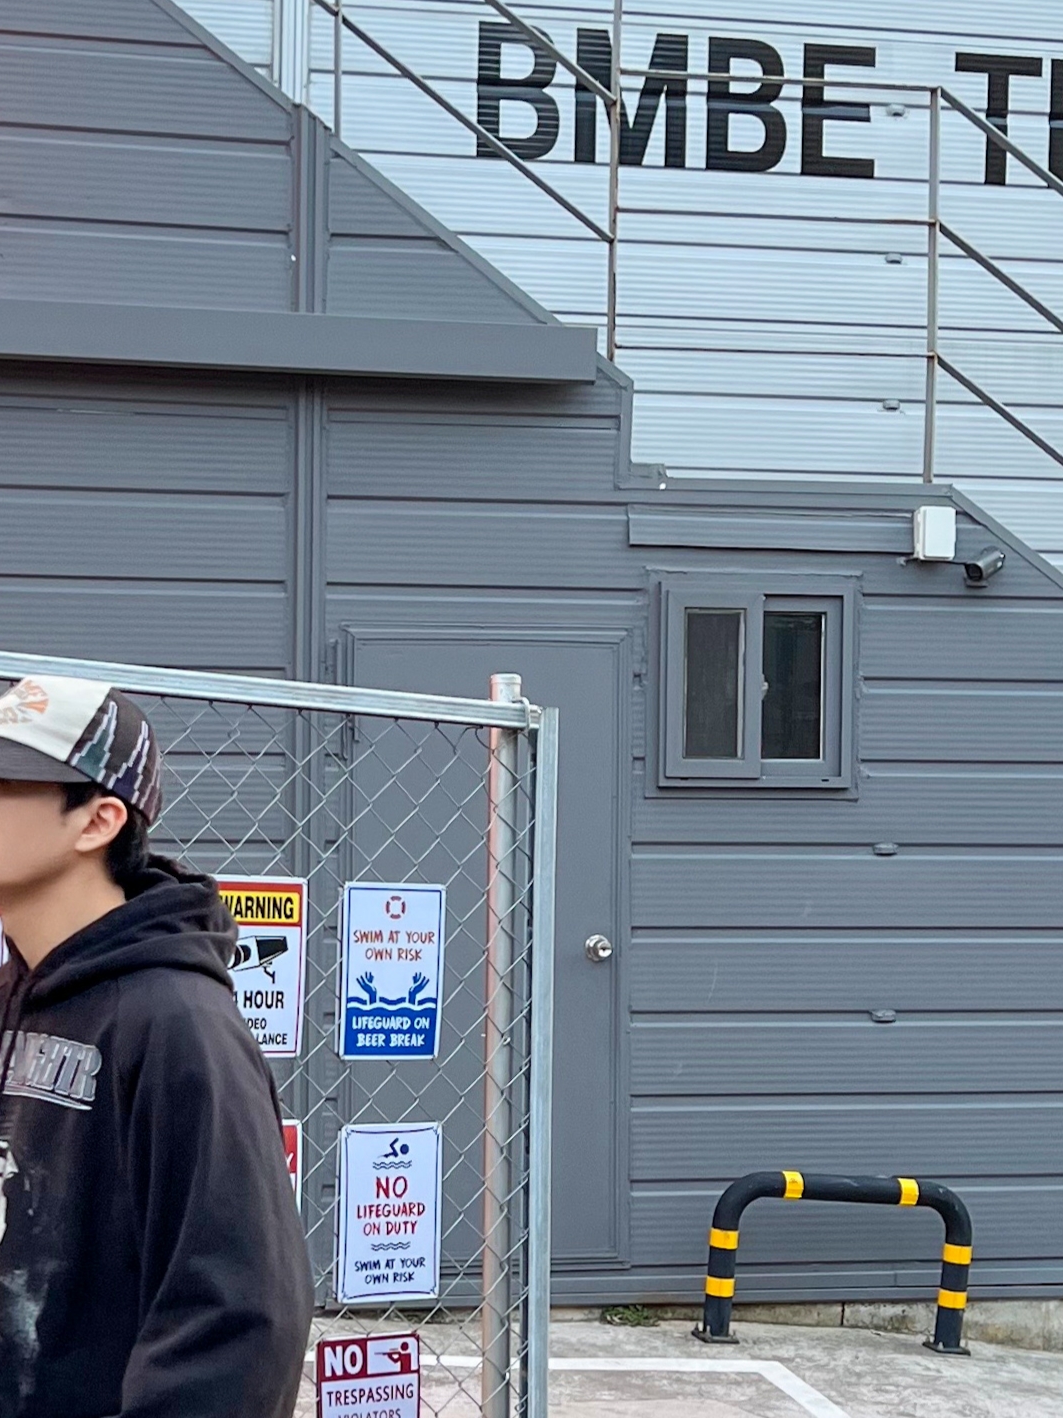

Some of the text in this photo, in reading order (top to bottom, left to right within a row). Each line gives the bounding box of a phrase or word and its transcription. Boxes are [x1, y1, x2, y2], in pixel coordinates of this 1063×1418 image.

[476, 20, 1063, 189] BMBE T
[353, 929, 435, 944] SWIM AT YOUR
[365, 947, 422, 961] OWN RISK
[243, 990, 285, 1009] HOUR
[351, 1015, 430, 1030] LIFEGUARD ON
[356, 1032, 425, 1047] BEER BREAK
[375, 1175, 408, 1199] NO
[356, 1202, 426, 1219] LIFEGUARD
[363, 1220, 418, 1236] ON DUTY
[354, 1256, 426, 1272] SWIM AT YOUR
[364, 1271, 415, 1285] OWN RISK
[324, 1344, 364, 1377] NO
[326, 1382, 414, 1408] TRESPASSING
